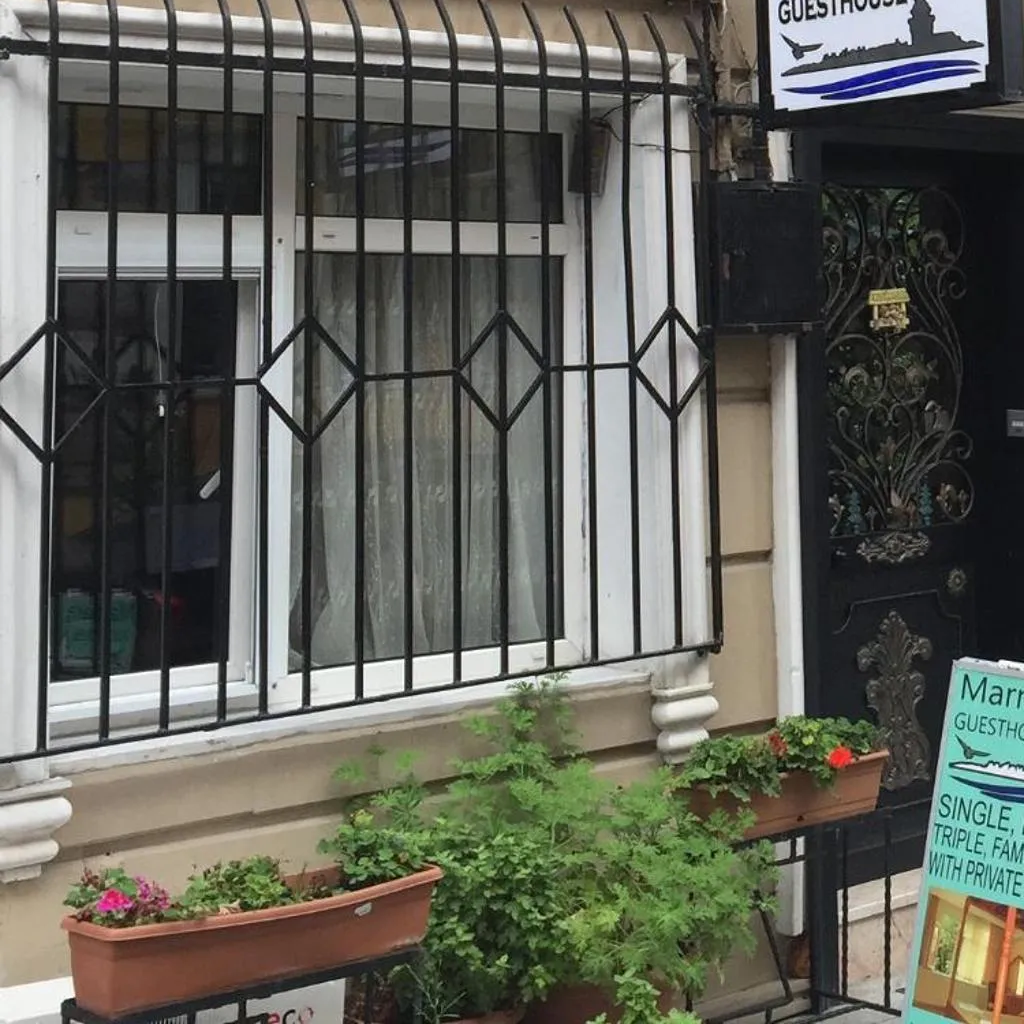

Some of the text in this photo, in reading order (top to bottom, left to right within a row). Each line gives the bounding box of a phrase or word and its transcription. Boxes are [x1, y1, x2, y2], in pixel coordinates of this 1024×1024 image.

[938, 793, 1014, 836] SINGLE,
[934, 823, 987, 858] TRIPLE,
[928, 850, 967, 878] WITH
[966, 860, 1021, 898] PRIVATE
